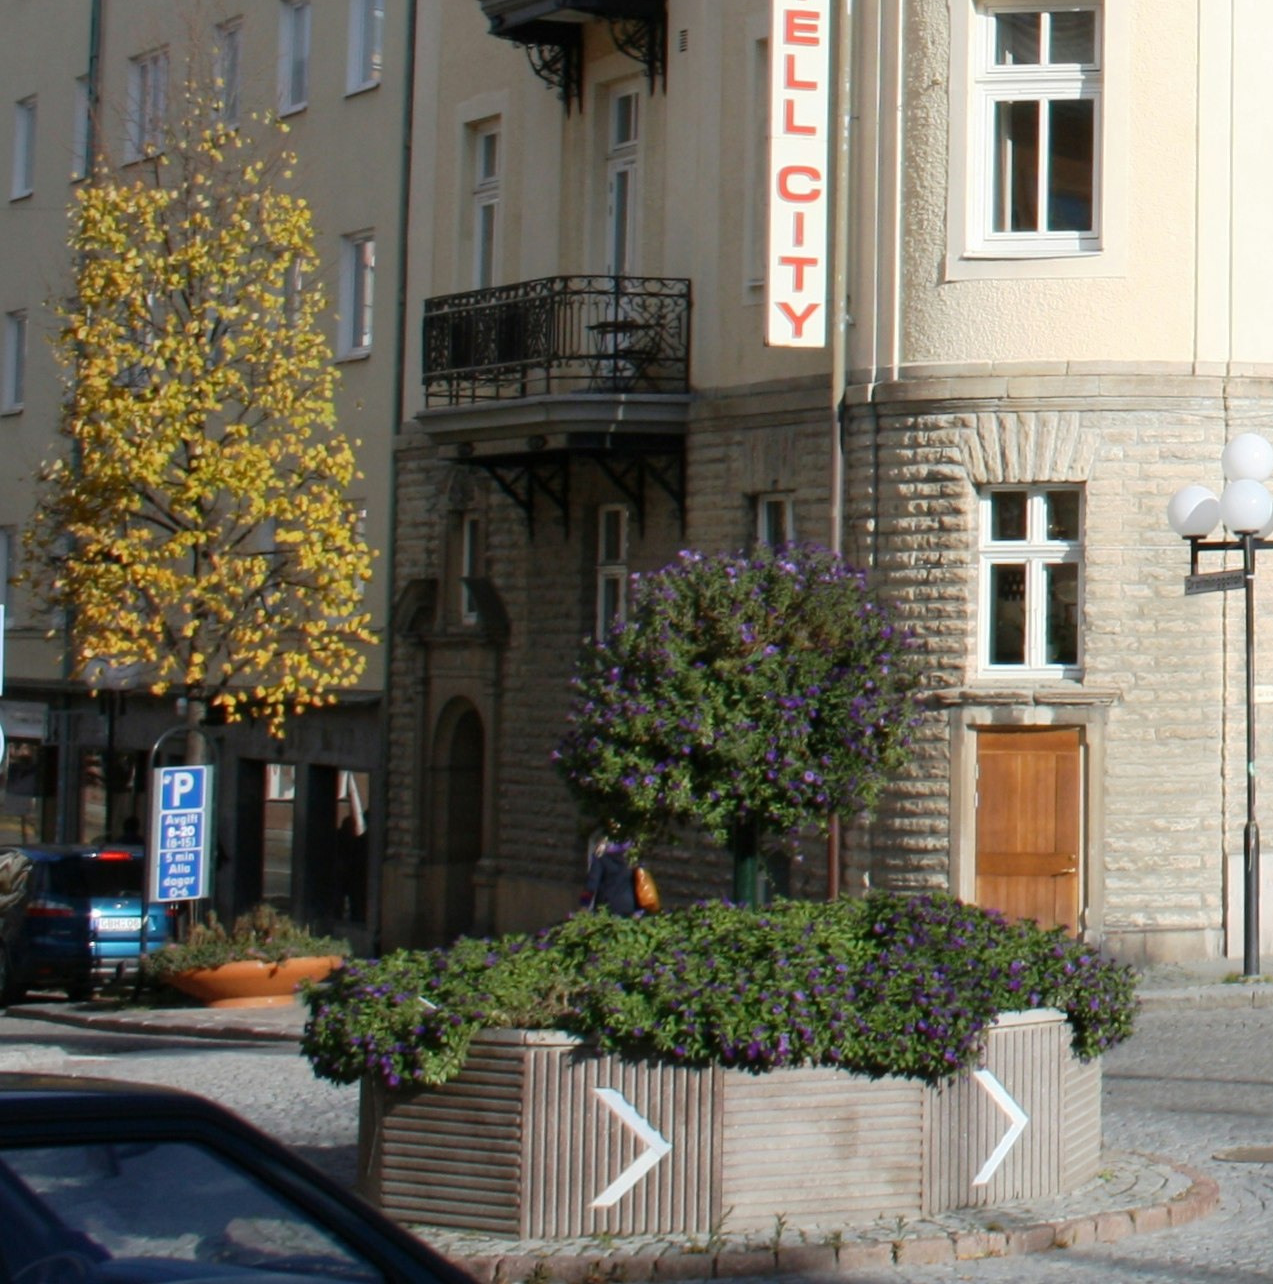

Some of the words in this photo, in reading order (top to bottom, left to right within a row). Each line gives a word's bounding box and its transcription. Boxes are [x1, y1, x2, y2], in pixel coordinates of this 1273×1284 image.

[776, 165, 821, 340] CITY
[172, 771, 195, 807] P
[165, 814, 198, 827] Avgift
[167, 825, 196, 837] 8-20
[165, 854, 172, 863] 5
[175, 851, 194, 862] min
[169, 863, 191, 874] Alla
[163, 876, 196, 887] dagar
